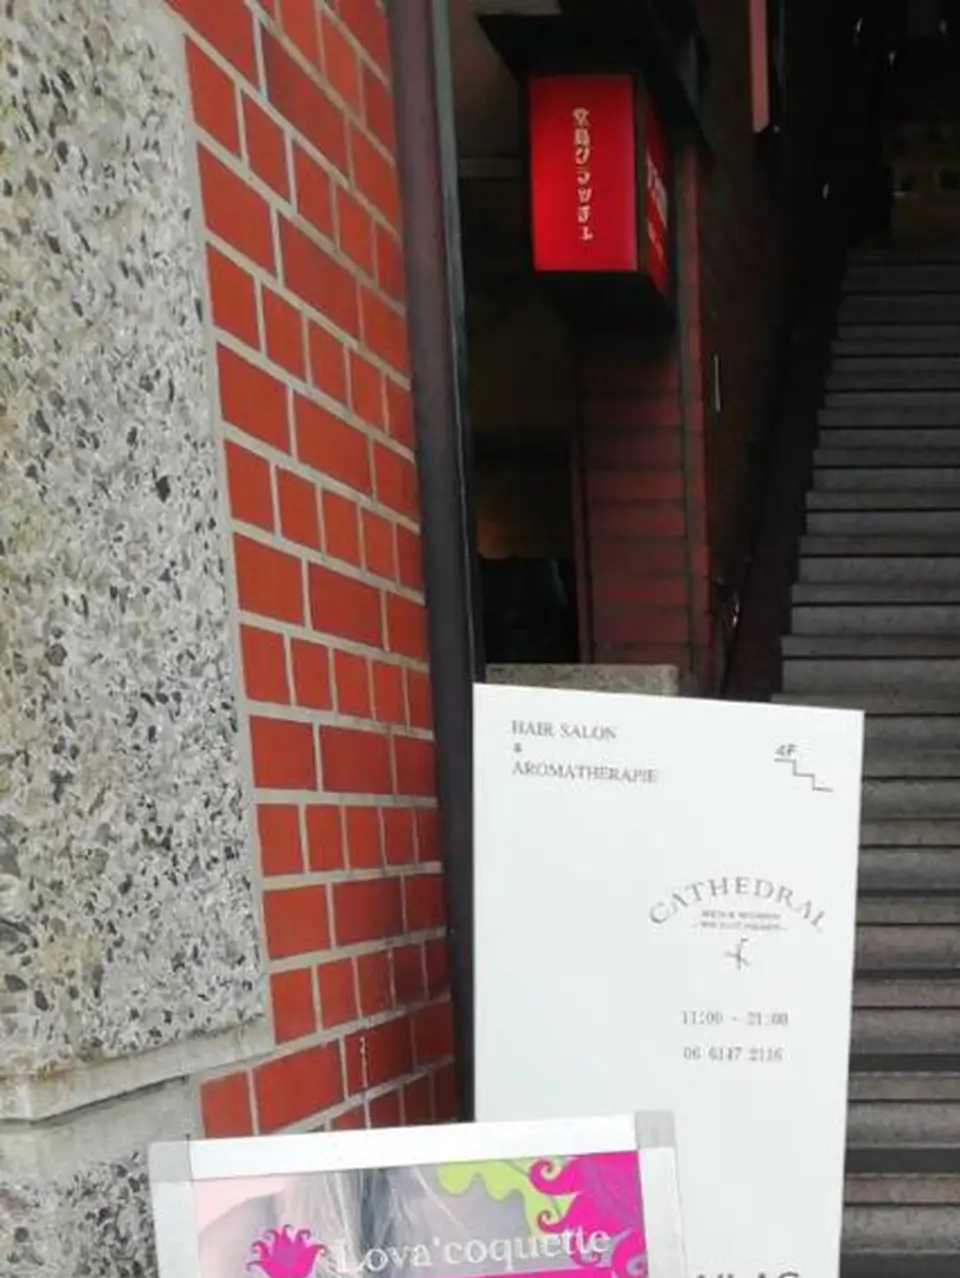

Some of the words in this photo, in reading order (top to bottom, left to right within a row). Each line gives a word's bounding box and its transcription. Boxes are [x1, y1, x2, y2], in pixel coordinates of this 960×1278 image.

[511, 719, 553, 737] HAIR
[559, 723, 616, 740] SALON
[511, 760, 658, 784] AROMATHERAPIE
[649, 876, 826, 933] CATHEDRAL
